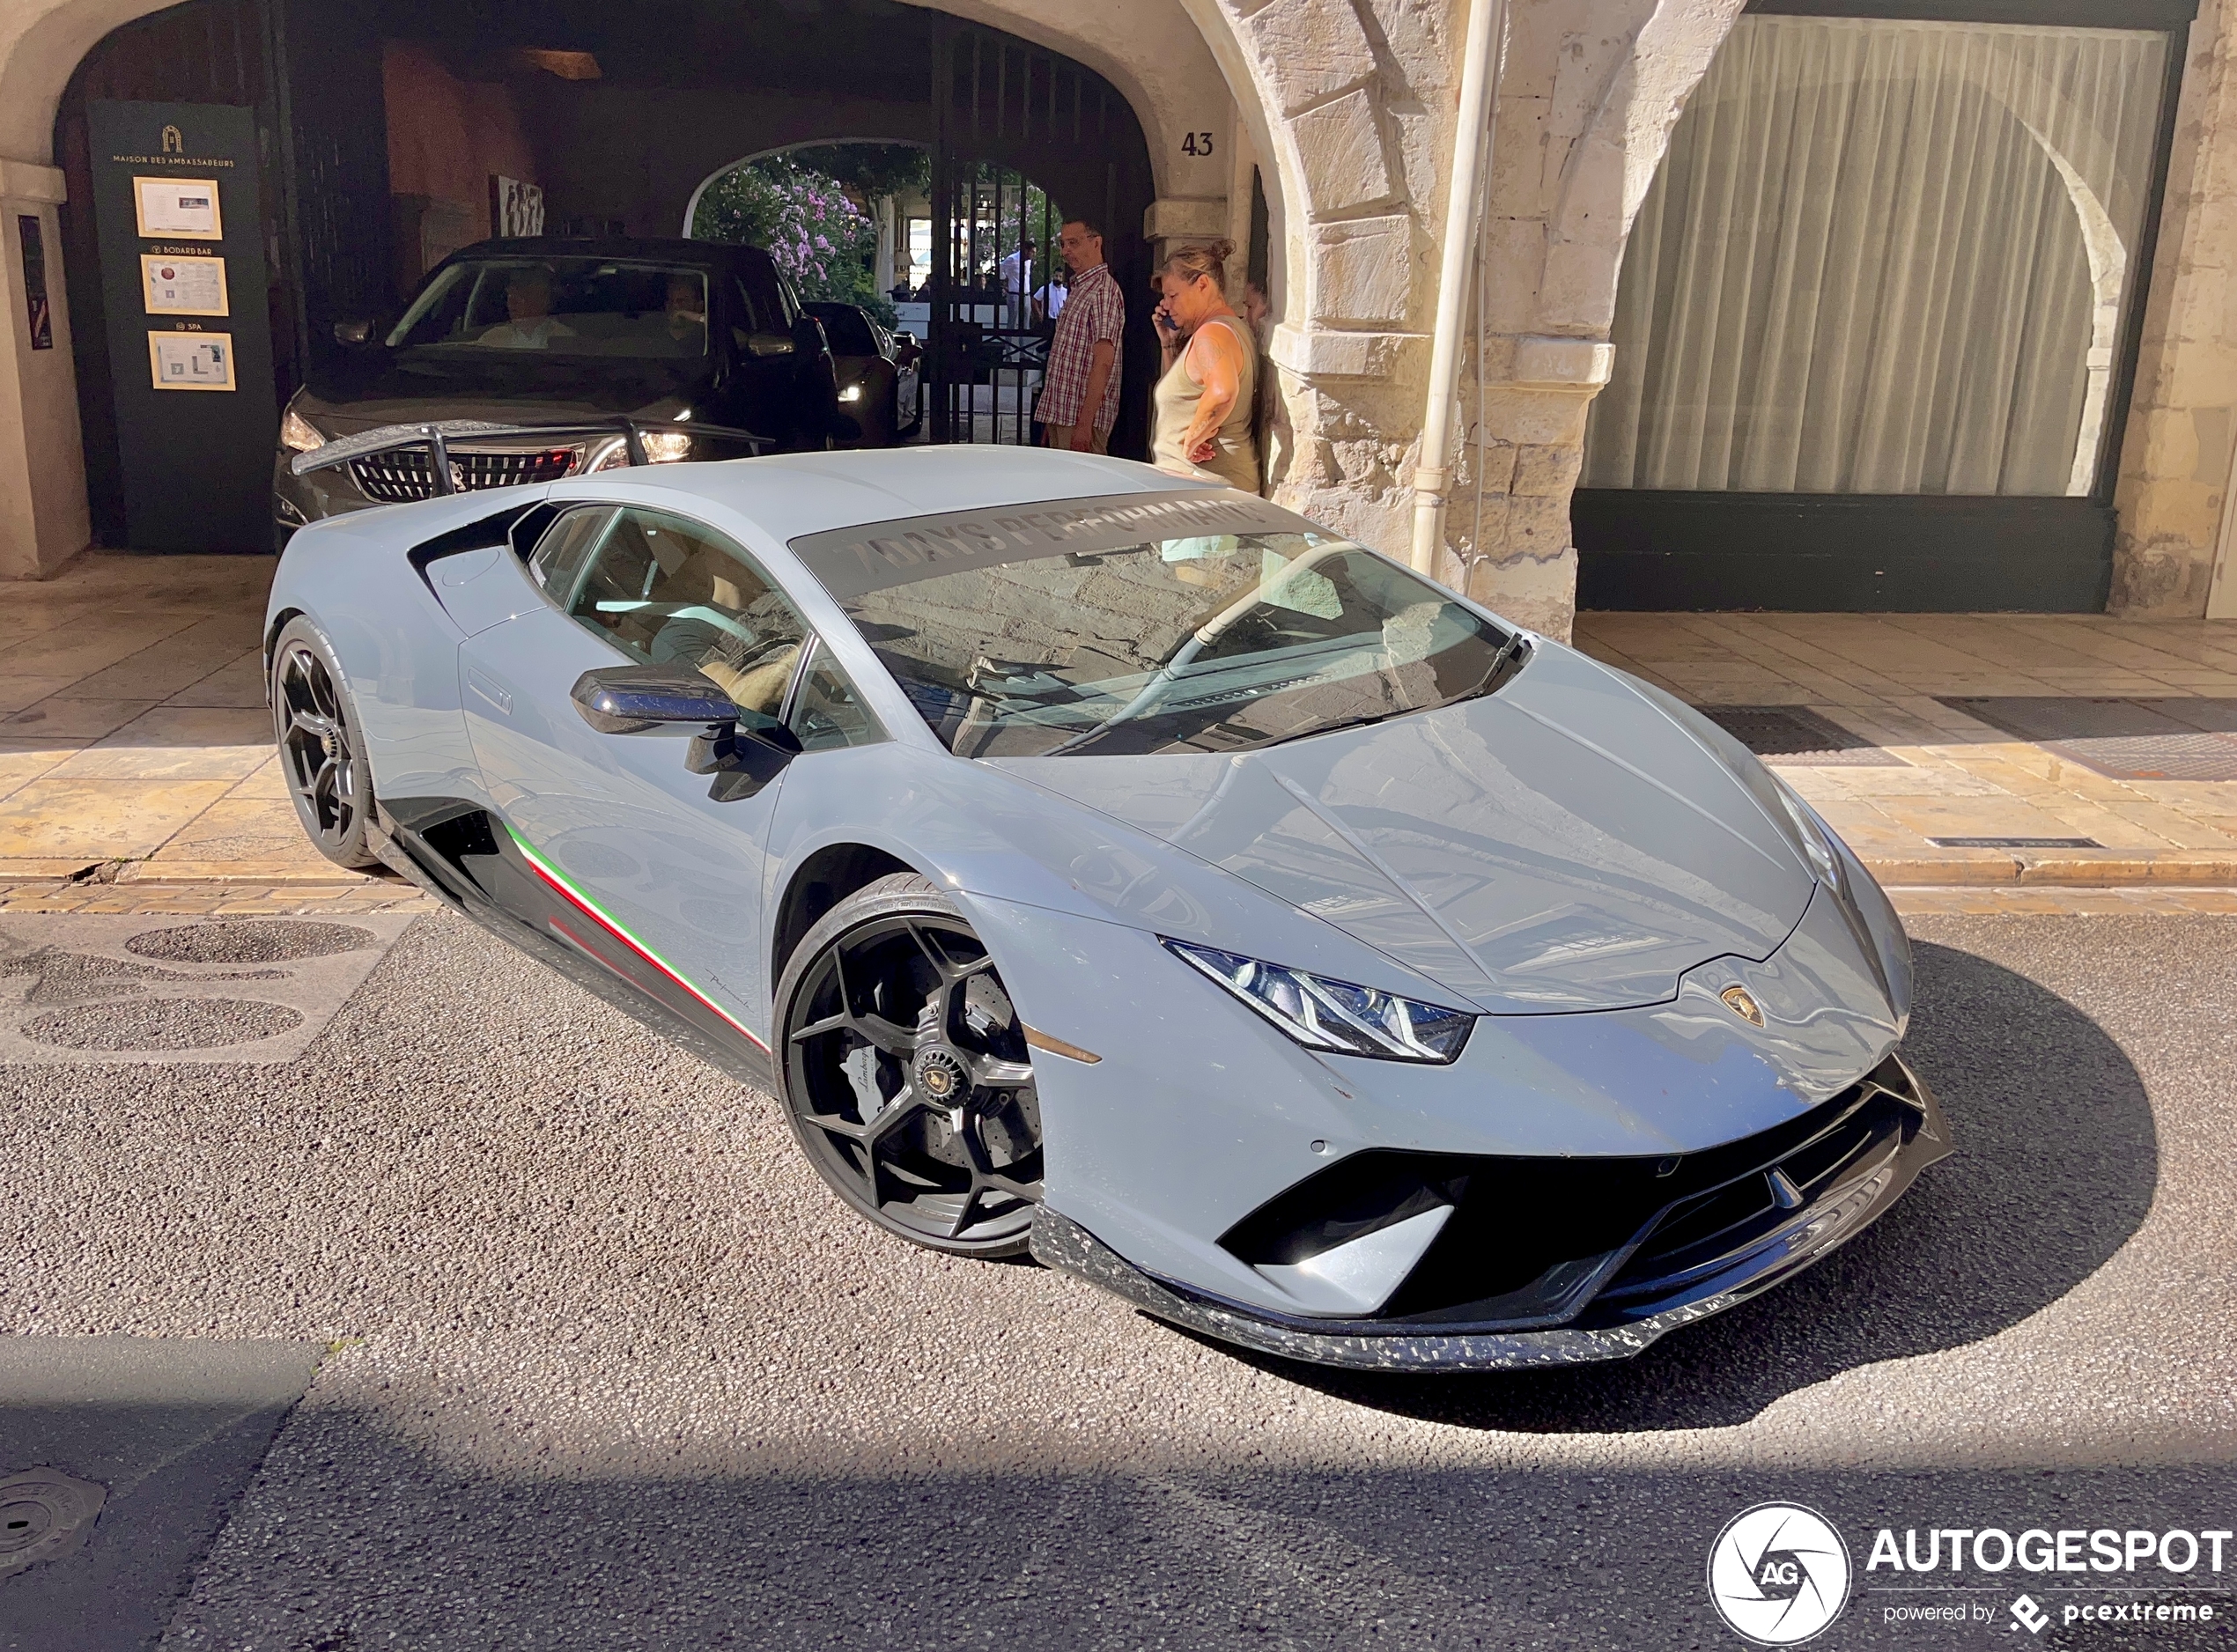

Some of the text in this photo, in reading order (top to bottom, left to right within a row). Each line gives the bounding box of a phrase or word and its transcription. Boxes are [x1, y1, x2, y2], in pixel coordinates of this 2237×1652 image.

[1181, 132, 1213, 156] 43
[113, 155, 148, 164] MAISON
[168, 158, 235, 168] AMBASSADEURS
[164, 246, 196, 255] BODARD
[858, 1047, 869, 1093] Lamborgh
